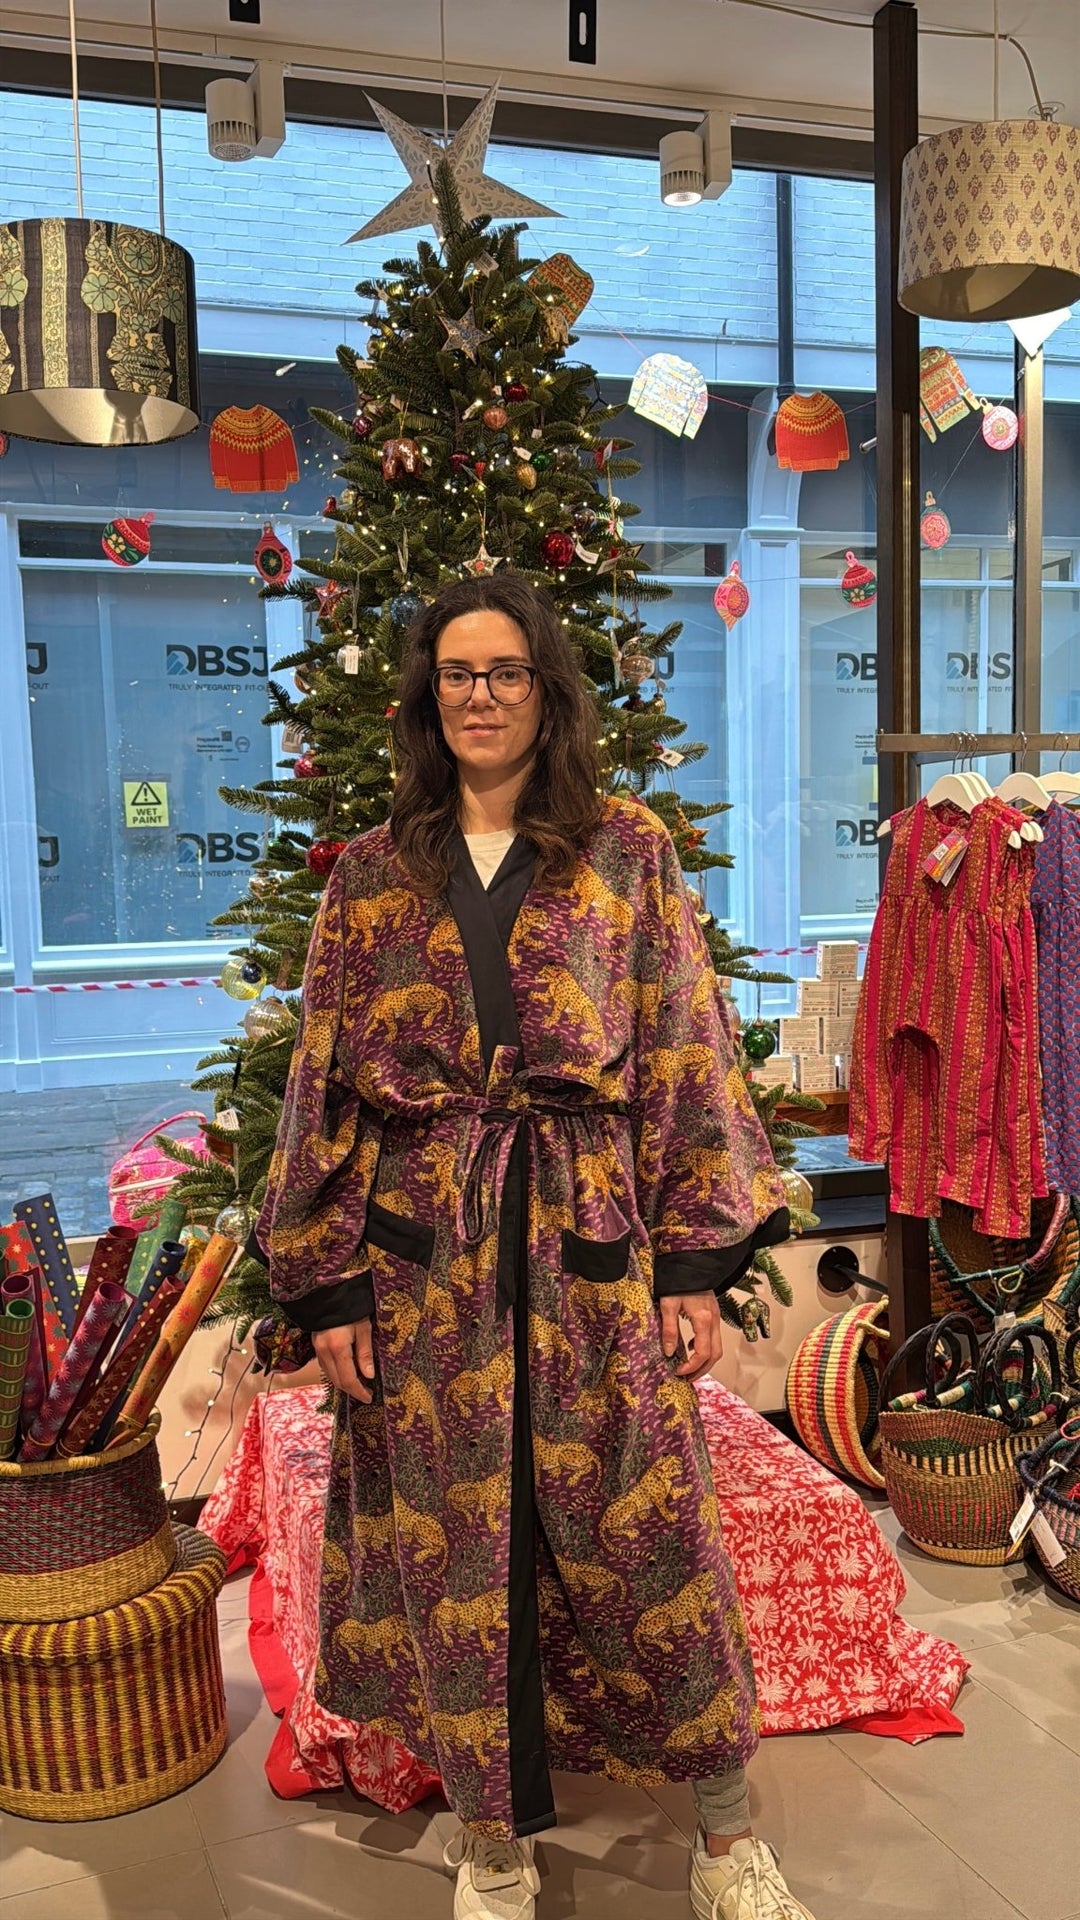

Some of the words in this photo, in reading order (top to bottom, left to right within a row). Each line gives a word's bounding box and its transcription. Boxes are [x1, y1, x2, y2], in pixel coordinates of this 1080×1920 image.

[166, 644, 268, 677] DBSJ
[837, 652, 878, 680] DB
[947, 652, 1011, 680] DBS
[28, 682, 49, 690] -OUT
[168, 683, 192, 691] TRULY
[195, 683, 242, 692] INTEGRATED
[132, 816, 163, 825] PAINT
[136, 808, 158, 816] WET
[836, 820, 879, 846] DB
[176, 832, 275, 863] DBS
